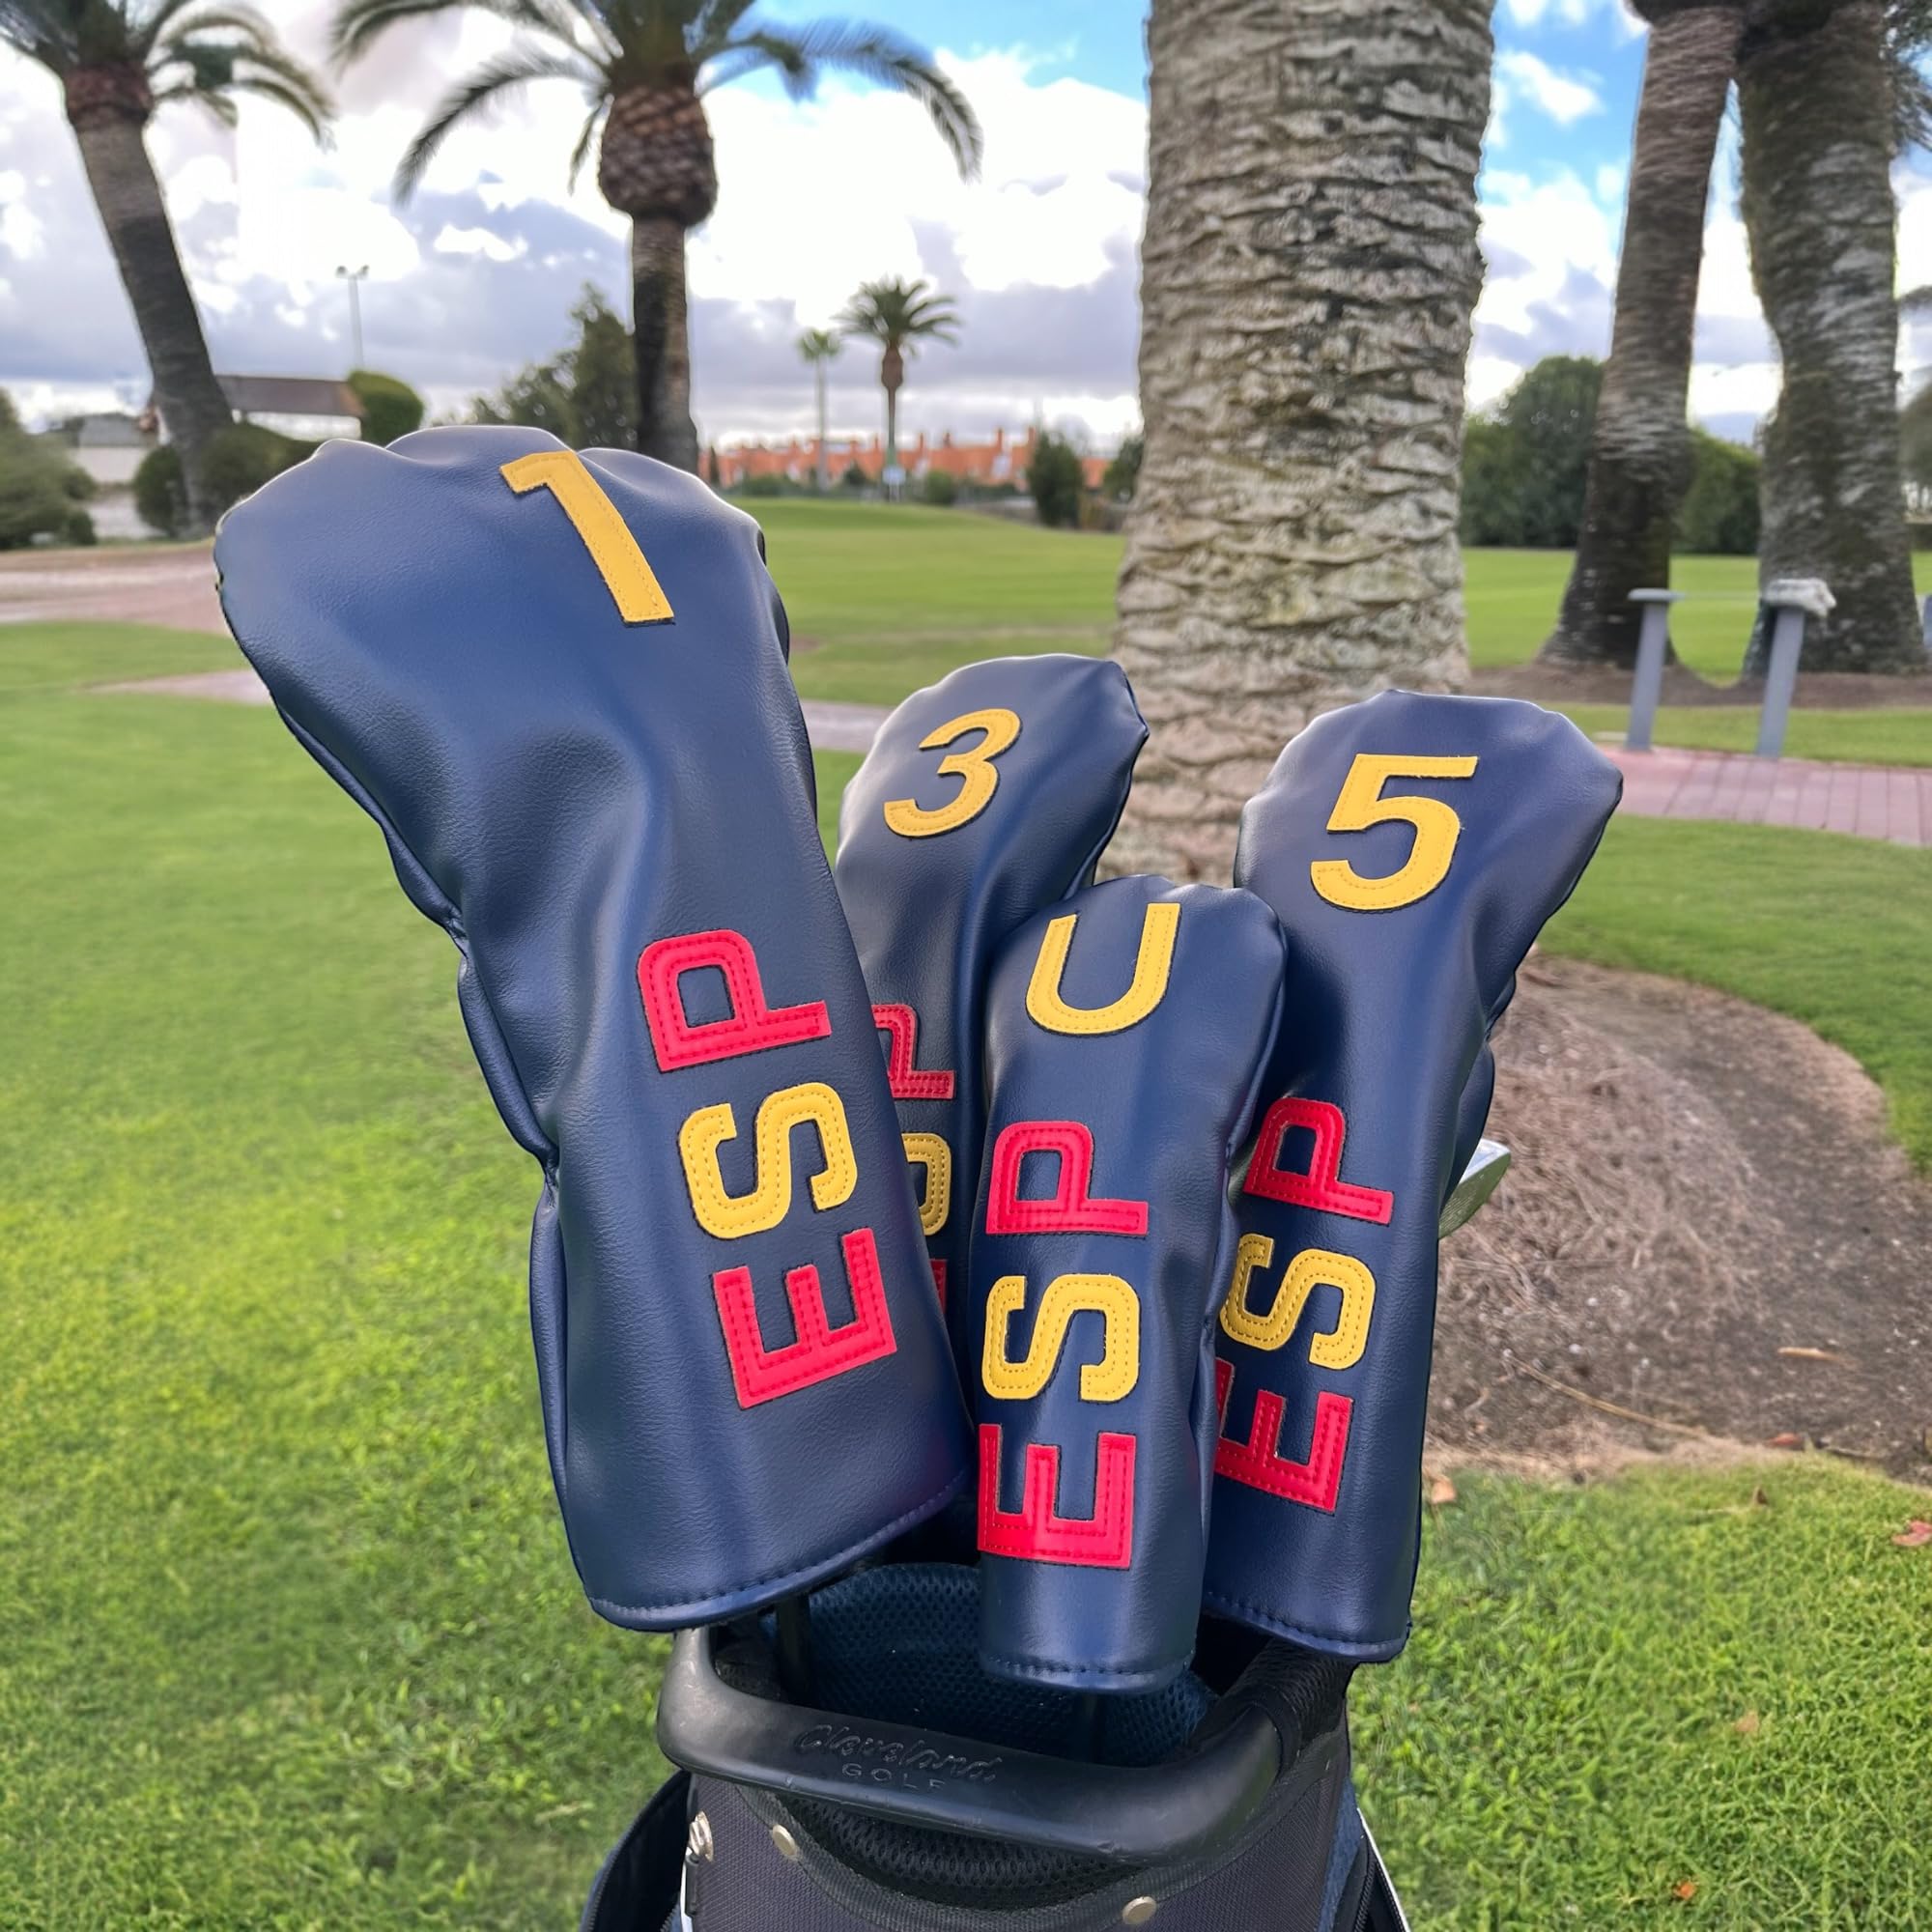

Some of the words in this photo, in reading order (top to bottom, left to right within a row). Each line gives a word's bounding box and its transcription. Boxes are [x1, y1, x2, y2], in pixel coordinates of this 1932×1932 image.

[500, 450, 674, 624] 1
[884, 708, 1021, 837] 3
[1311, 753, 1479, 911] 5
[1026, 902, 1180, 1035] U
[638, 929, 897, 1408] ESP
[978, 1121, 1149, 1569] ESP
[1215, 1096, 1394, 1515] ESP
[793, 1724, 1003, 1783] Cleveland
[841, 1762, 946, 1789] GOLF
